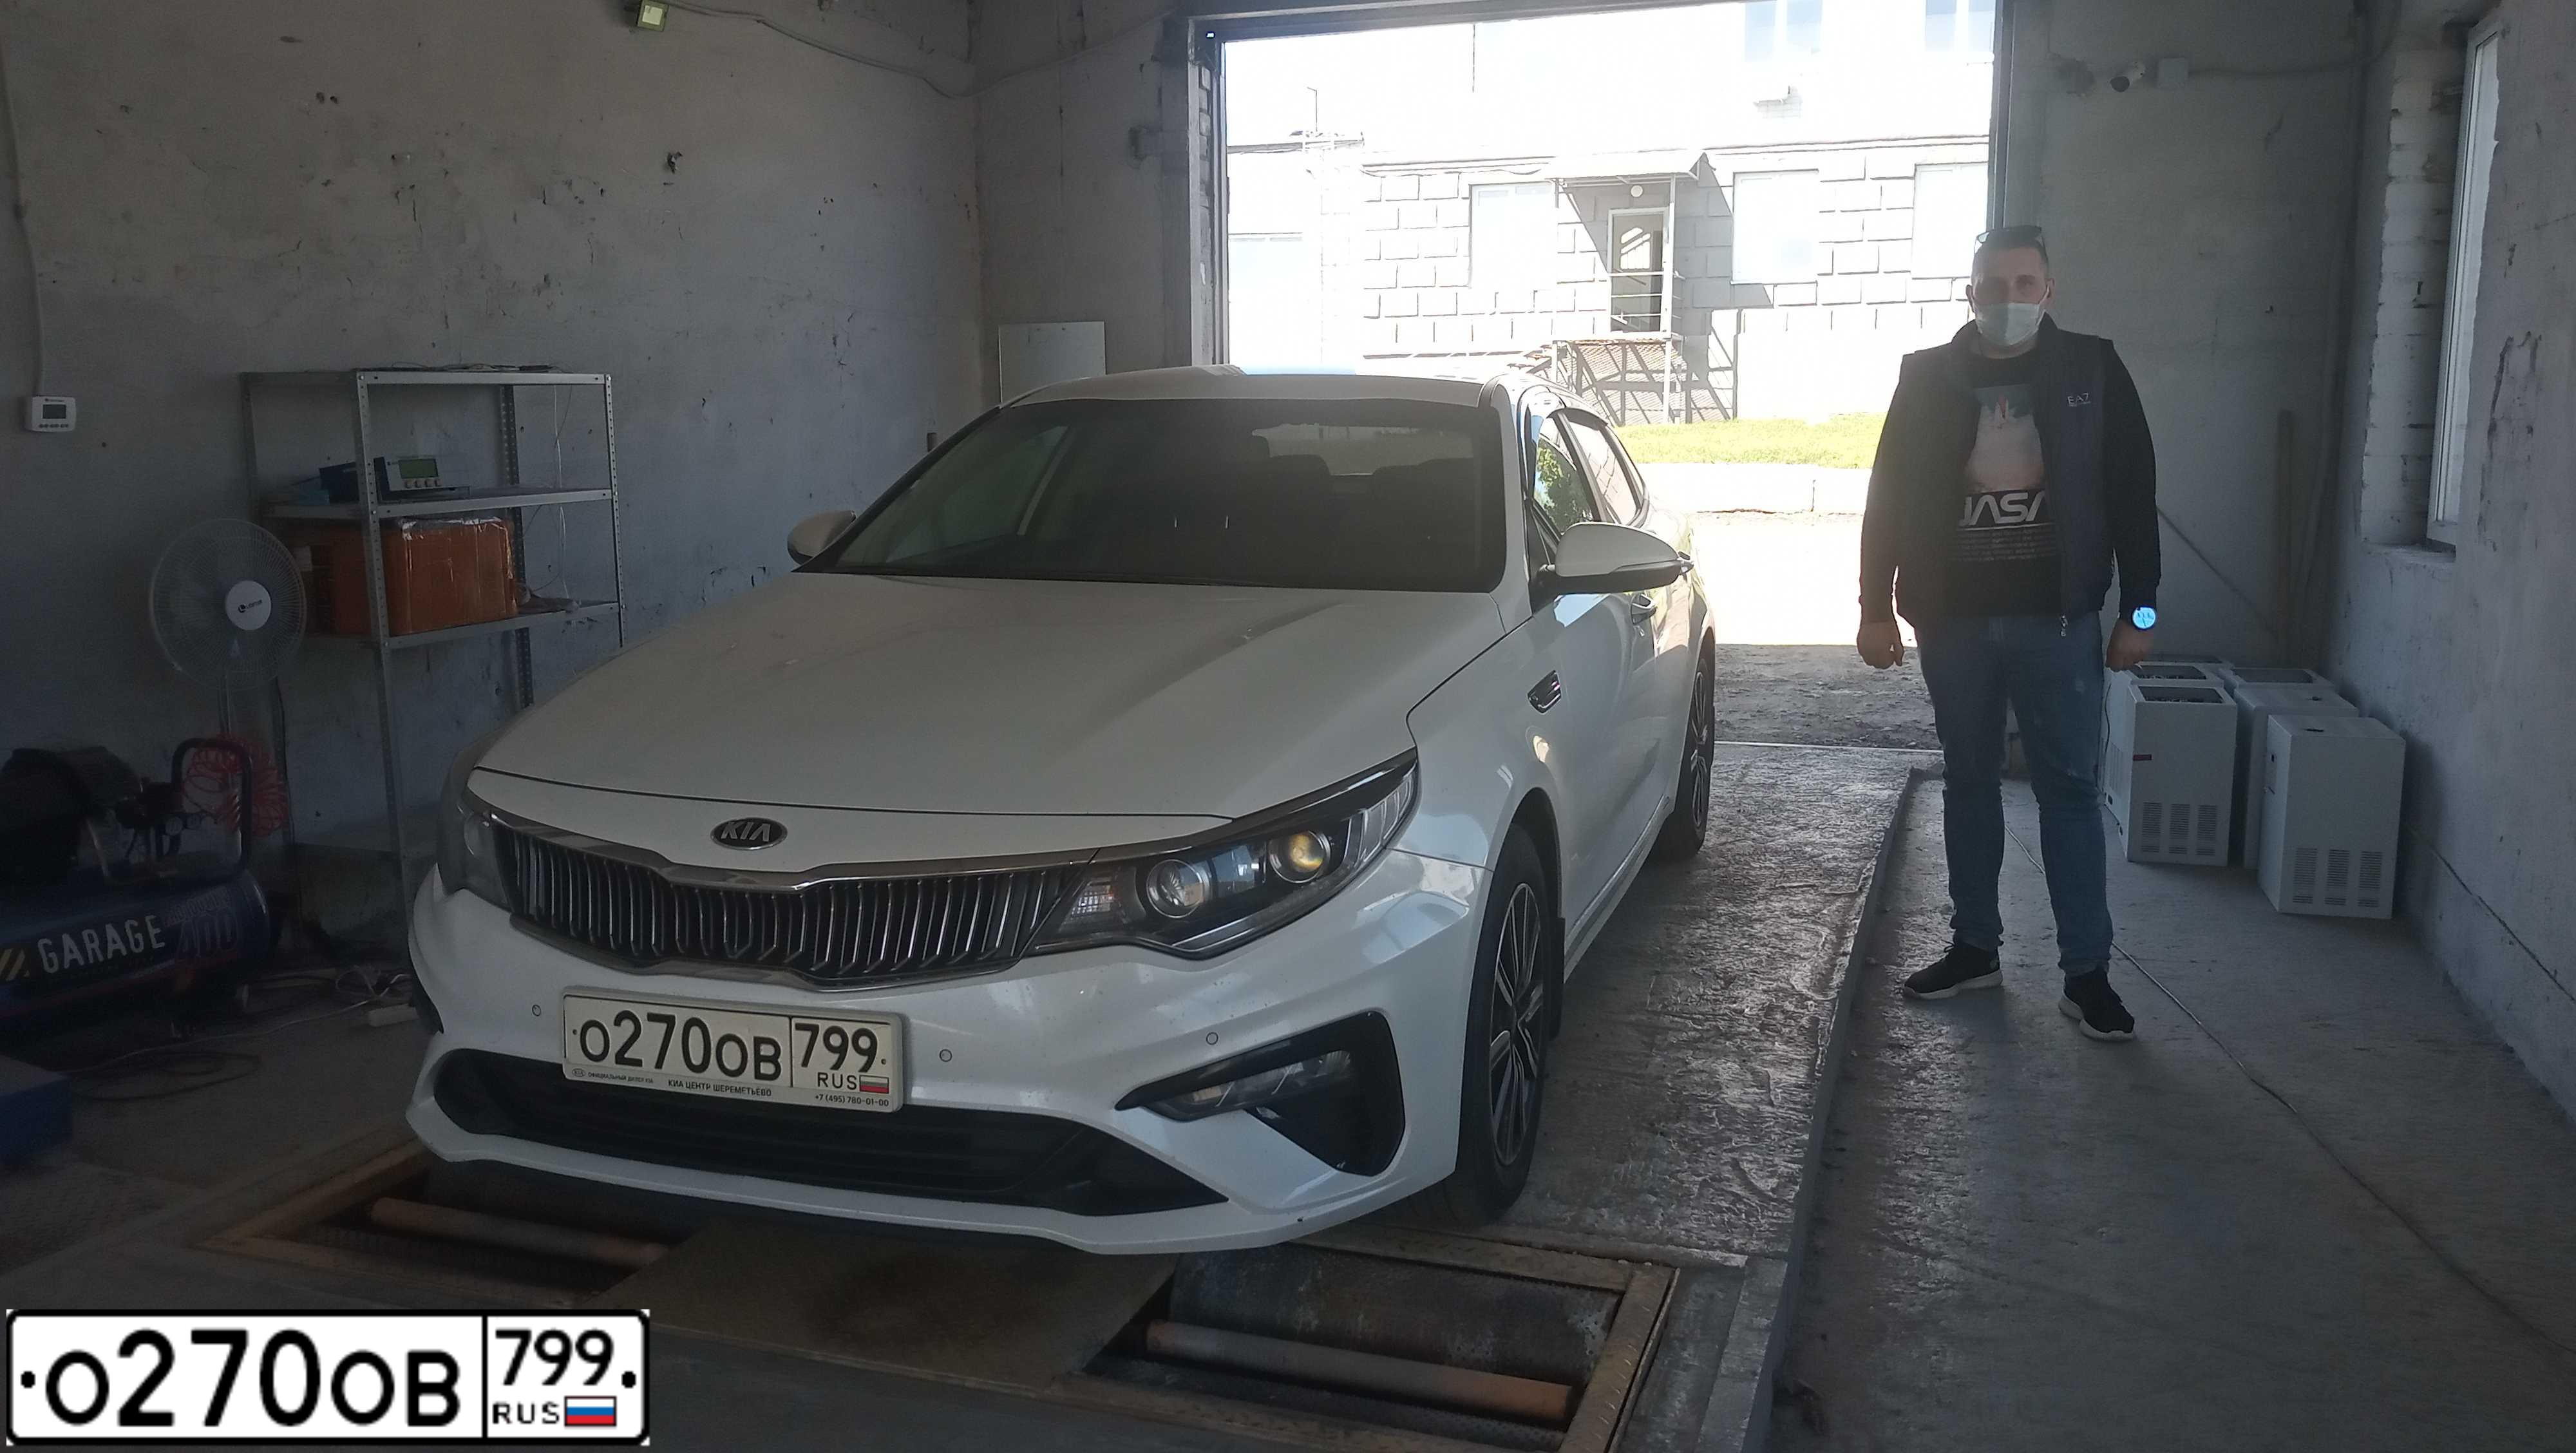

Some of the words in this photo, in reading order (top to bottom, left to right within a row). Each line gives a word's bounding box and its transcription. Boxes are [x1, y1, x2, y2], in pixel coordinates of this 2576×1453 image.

[2067, 392, 2089, 405] EA7
[721, 821, 772, 842] KIA
[37, 915, 166, 974] GARAGE
[579, 1009, 782, 1081] О270ОВ
[795, 1022, 878, 1073] 799
[668, 1079, 684, 1088] КИА
[685, 1081, 711, 1090] ЦЕНТР
[713, 1084, 772, 1097] ШЕРЕМЕТЬЕВО
[817, 1072, 857, 1090] RUS
[825, 1094, 846, 1103] (495)
[848, 1096, 889, 1106] 780-01-00
